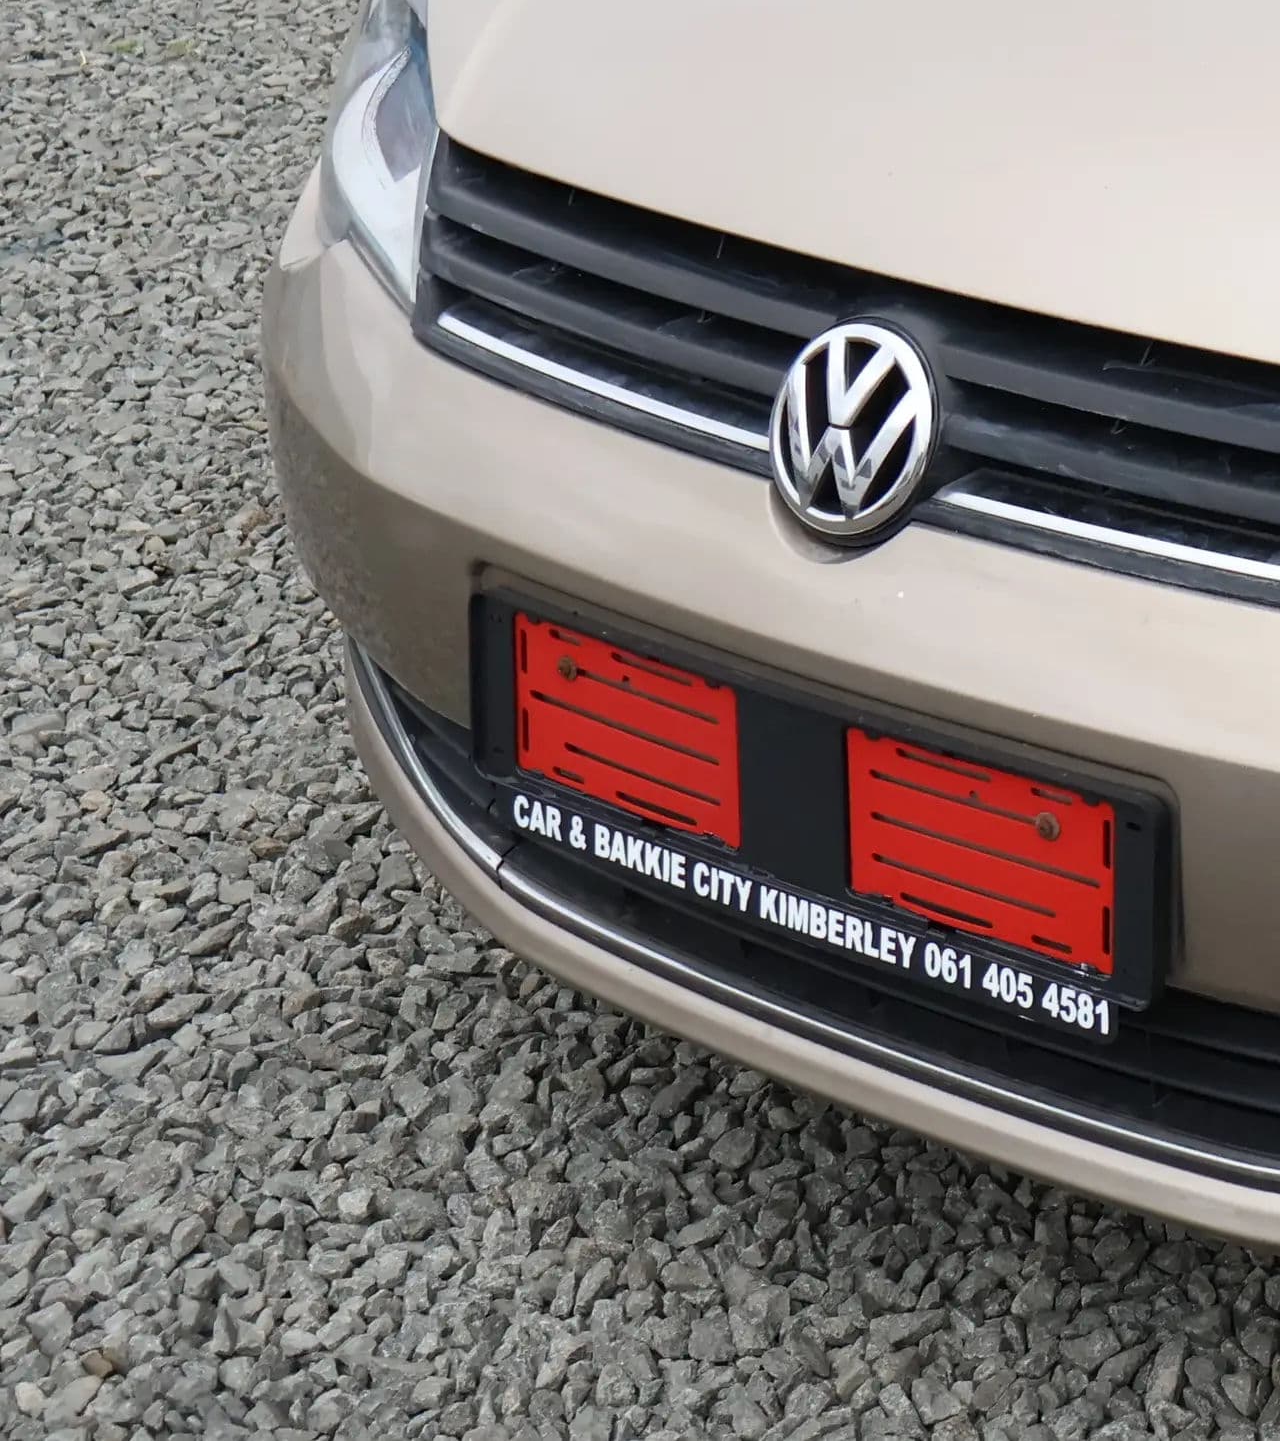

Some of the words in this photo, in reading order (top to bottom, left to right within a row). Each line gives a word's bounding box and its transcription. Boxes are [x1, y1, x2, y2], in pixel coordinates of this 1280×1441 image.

[512, 794, 562, 841] CAR
[569, 818, 587, 847] &
[593, 823, 687, 889] BAKKIE
[691, 866, 753, 911] CITY
[758, 884, 915, 970] KIMBERLEY
[923, 942, 972, 990] 061
[982, 965, 1034, 1011] 405
[1041, 983, 1110, 1036] 4581
